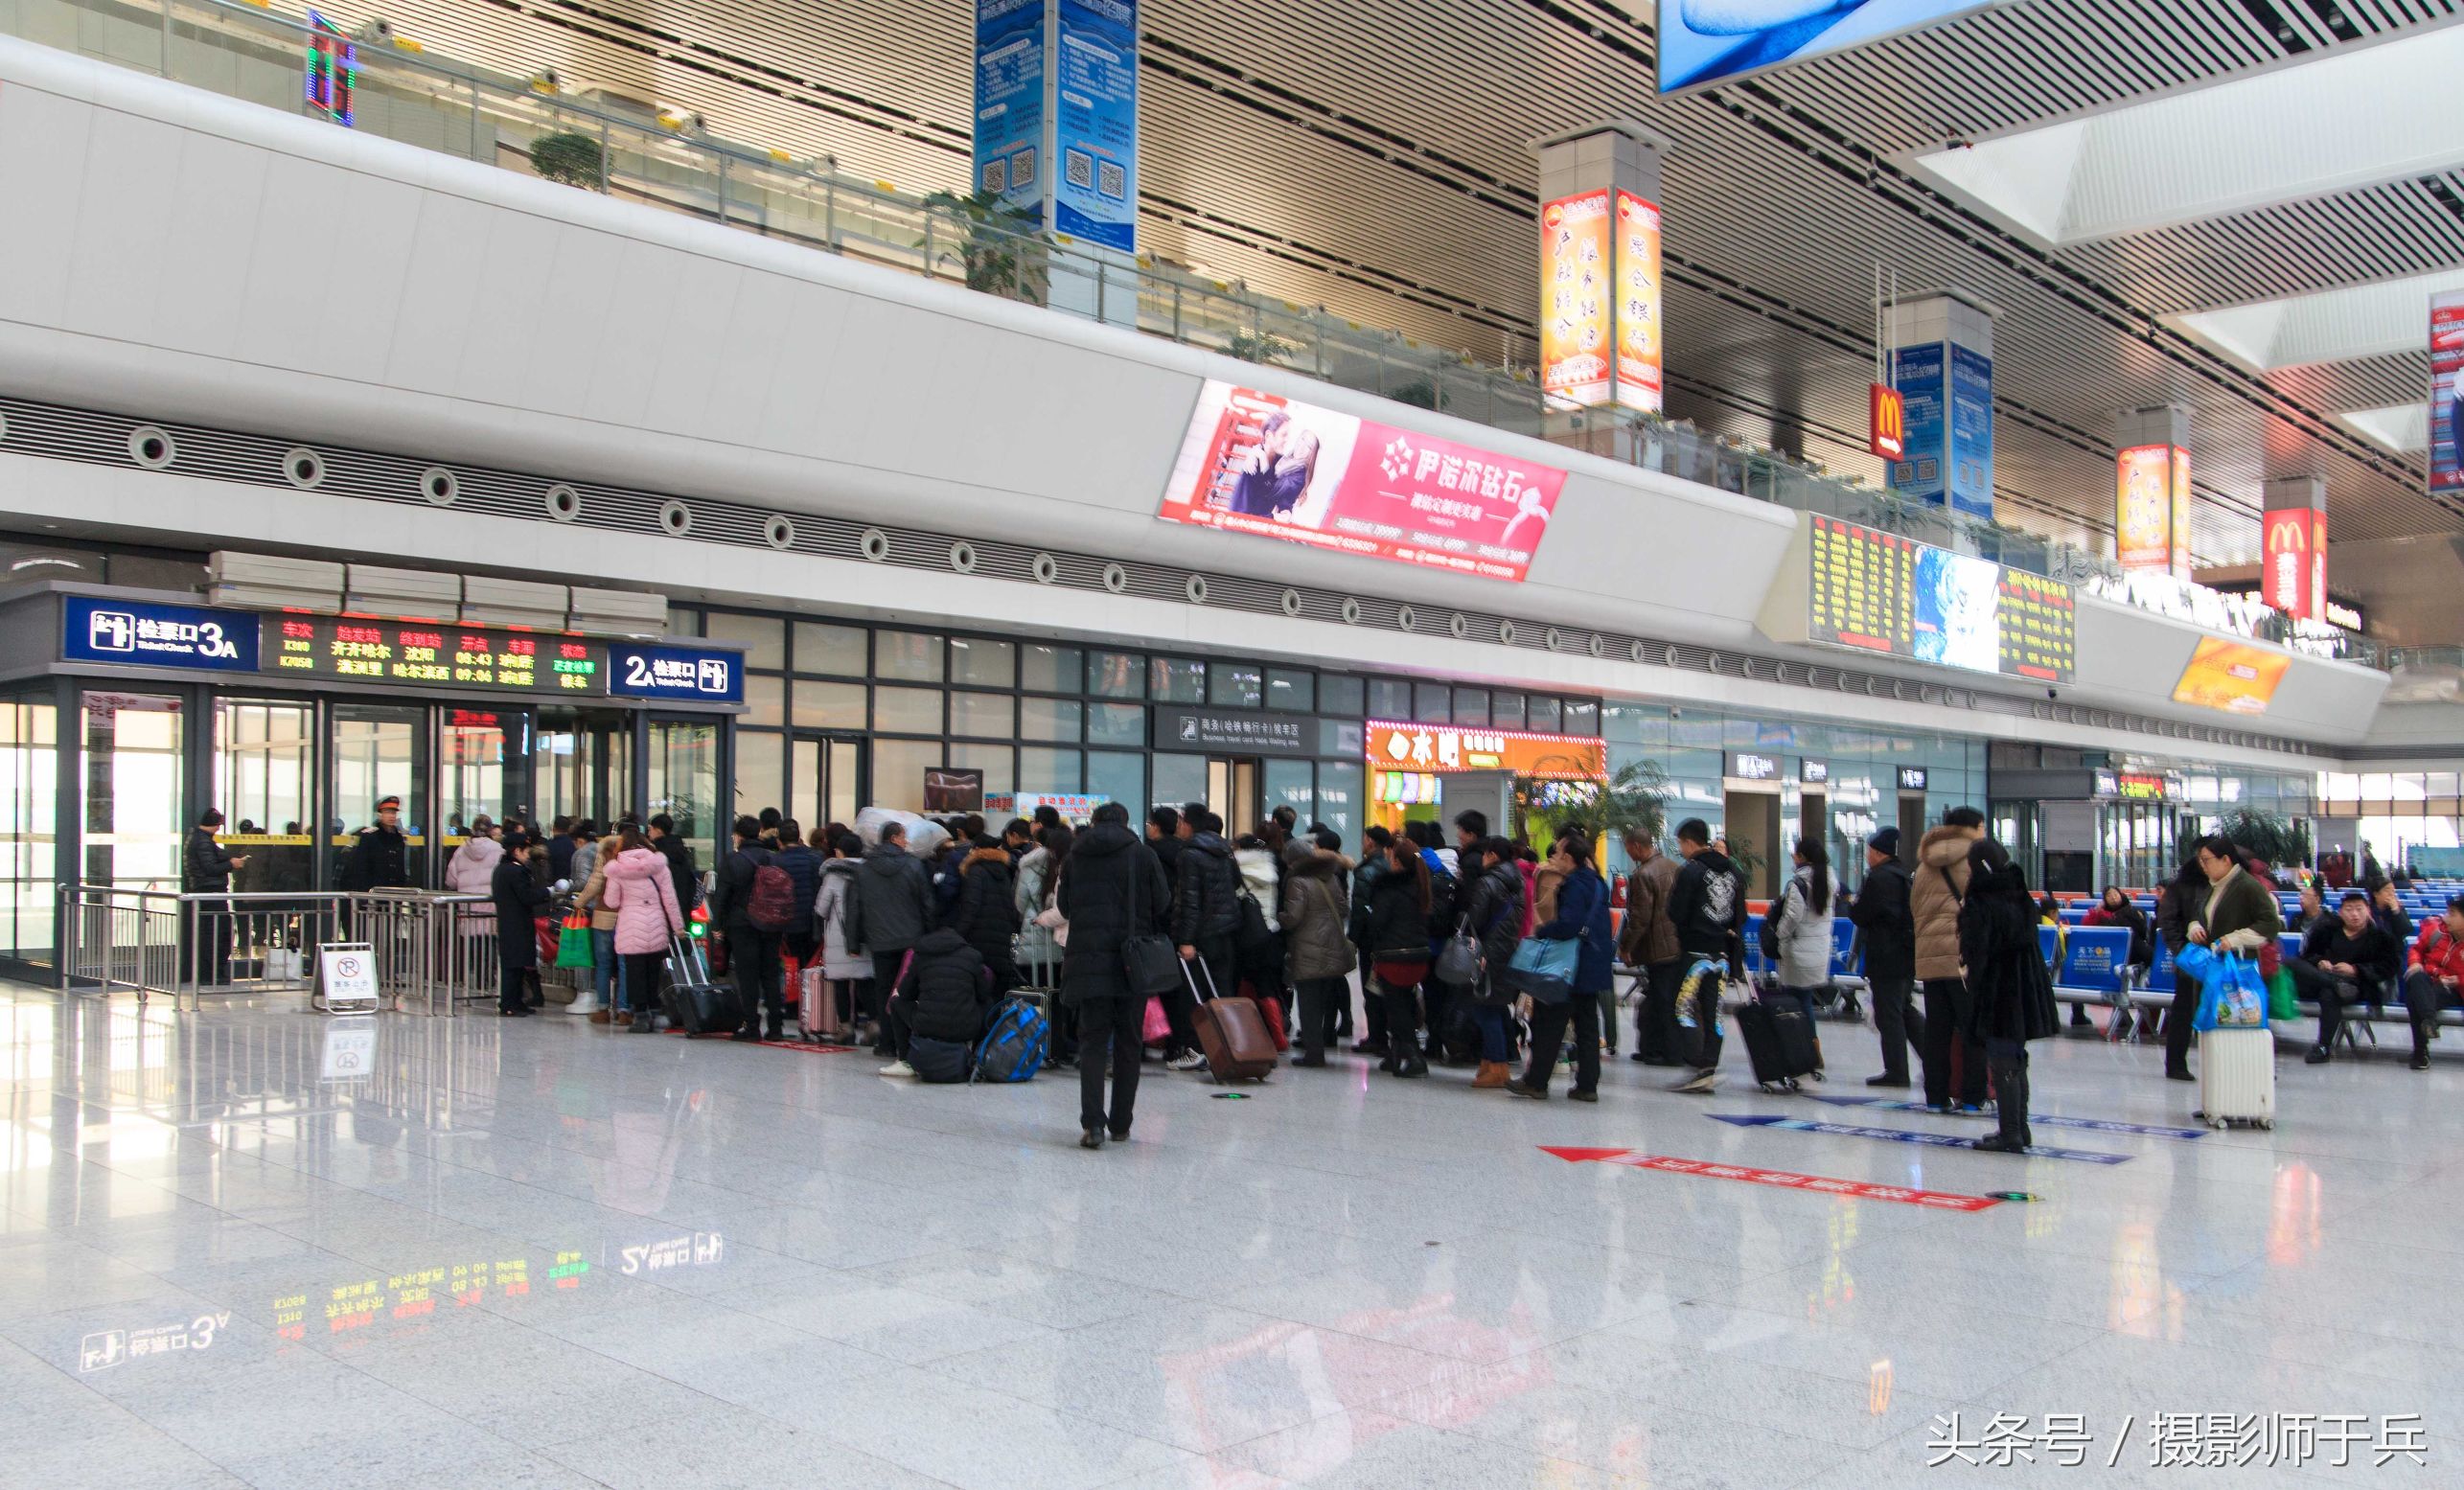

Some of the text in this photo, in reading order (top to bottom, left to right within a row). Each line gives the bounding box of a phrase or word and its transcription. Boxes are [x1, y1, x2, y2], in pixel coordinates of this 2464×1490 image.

[1414, 448, 1526, 504] 伊诺尔钻石
[136, 618, 239, 658] 检票口 3A
[283, 621, 313, 639] 车次
[337, 626, 382, 644] 始发站
[399, 630, 443, 650] 终到站
[461, 635, 489, 653] 开点
[331, 640, 391, 659] 齐齐哈尔
[404, 647, 435, 662] 沈阳
[455, 652, 493, 667] 08:43
[337, 659, 383, 676] 满洲里
[392, 663, 450, 680] 哈尔滨西
[455, 668, 493, 683] 09:06
[625, 655, 695, 687] 2A 检票口
